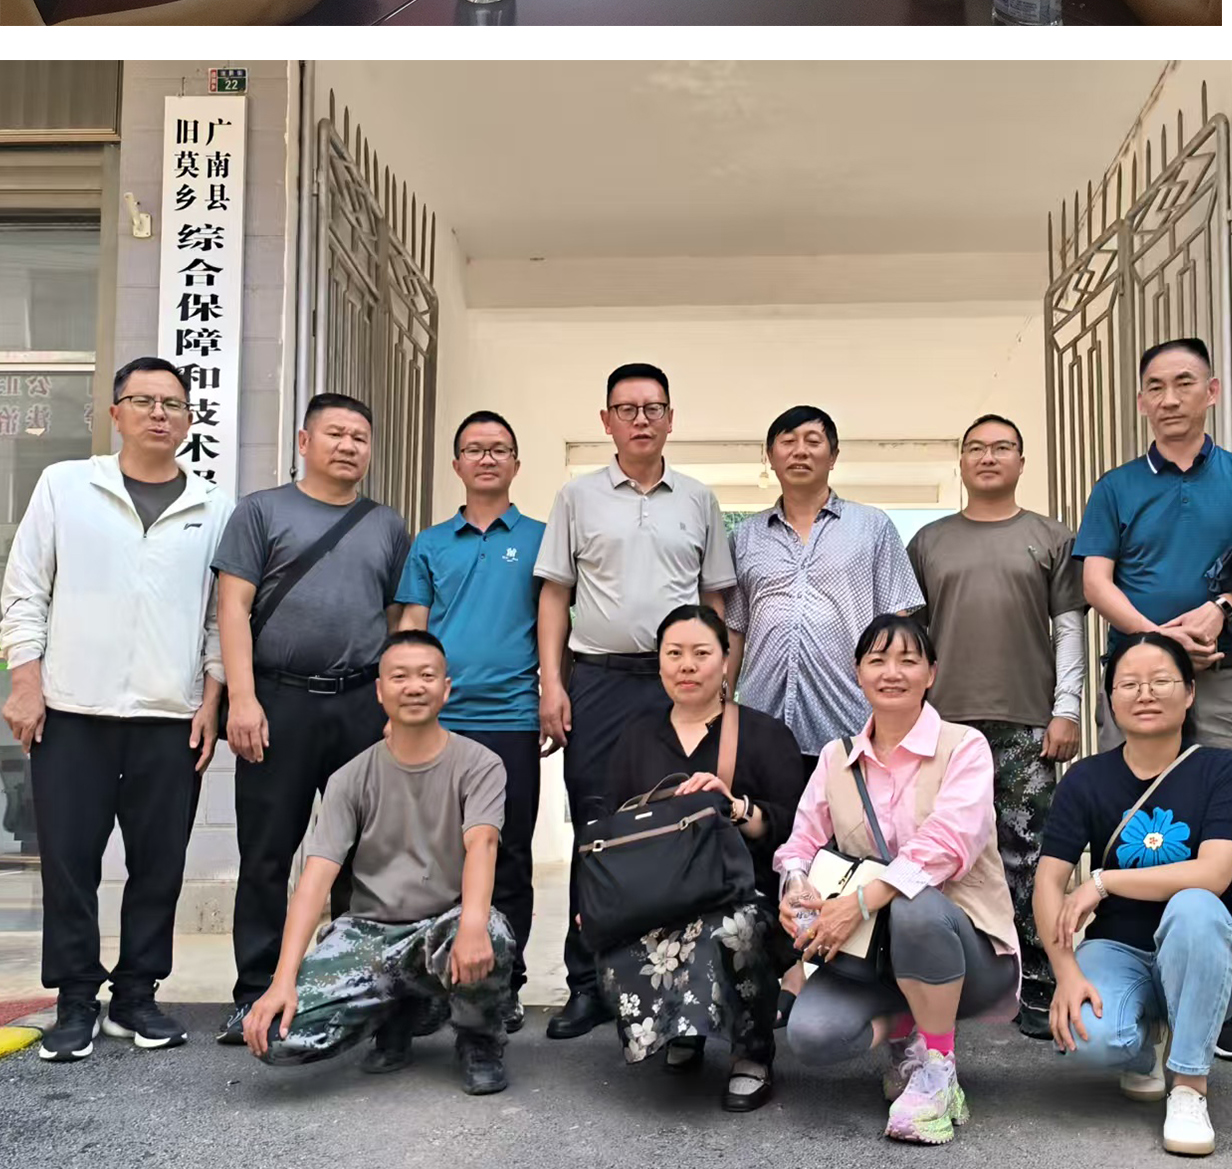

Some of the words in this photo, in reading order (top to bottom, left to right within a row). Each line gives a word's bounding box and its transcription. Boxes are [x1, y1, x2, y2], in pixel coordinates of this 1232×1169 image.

[225, 79, 239, 90] 22
[174, 118, 199, 211] 旧莫乡
[204, 118, 232, 211] 广南县
